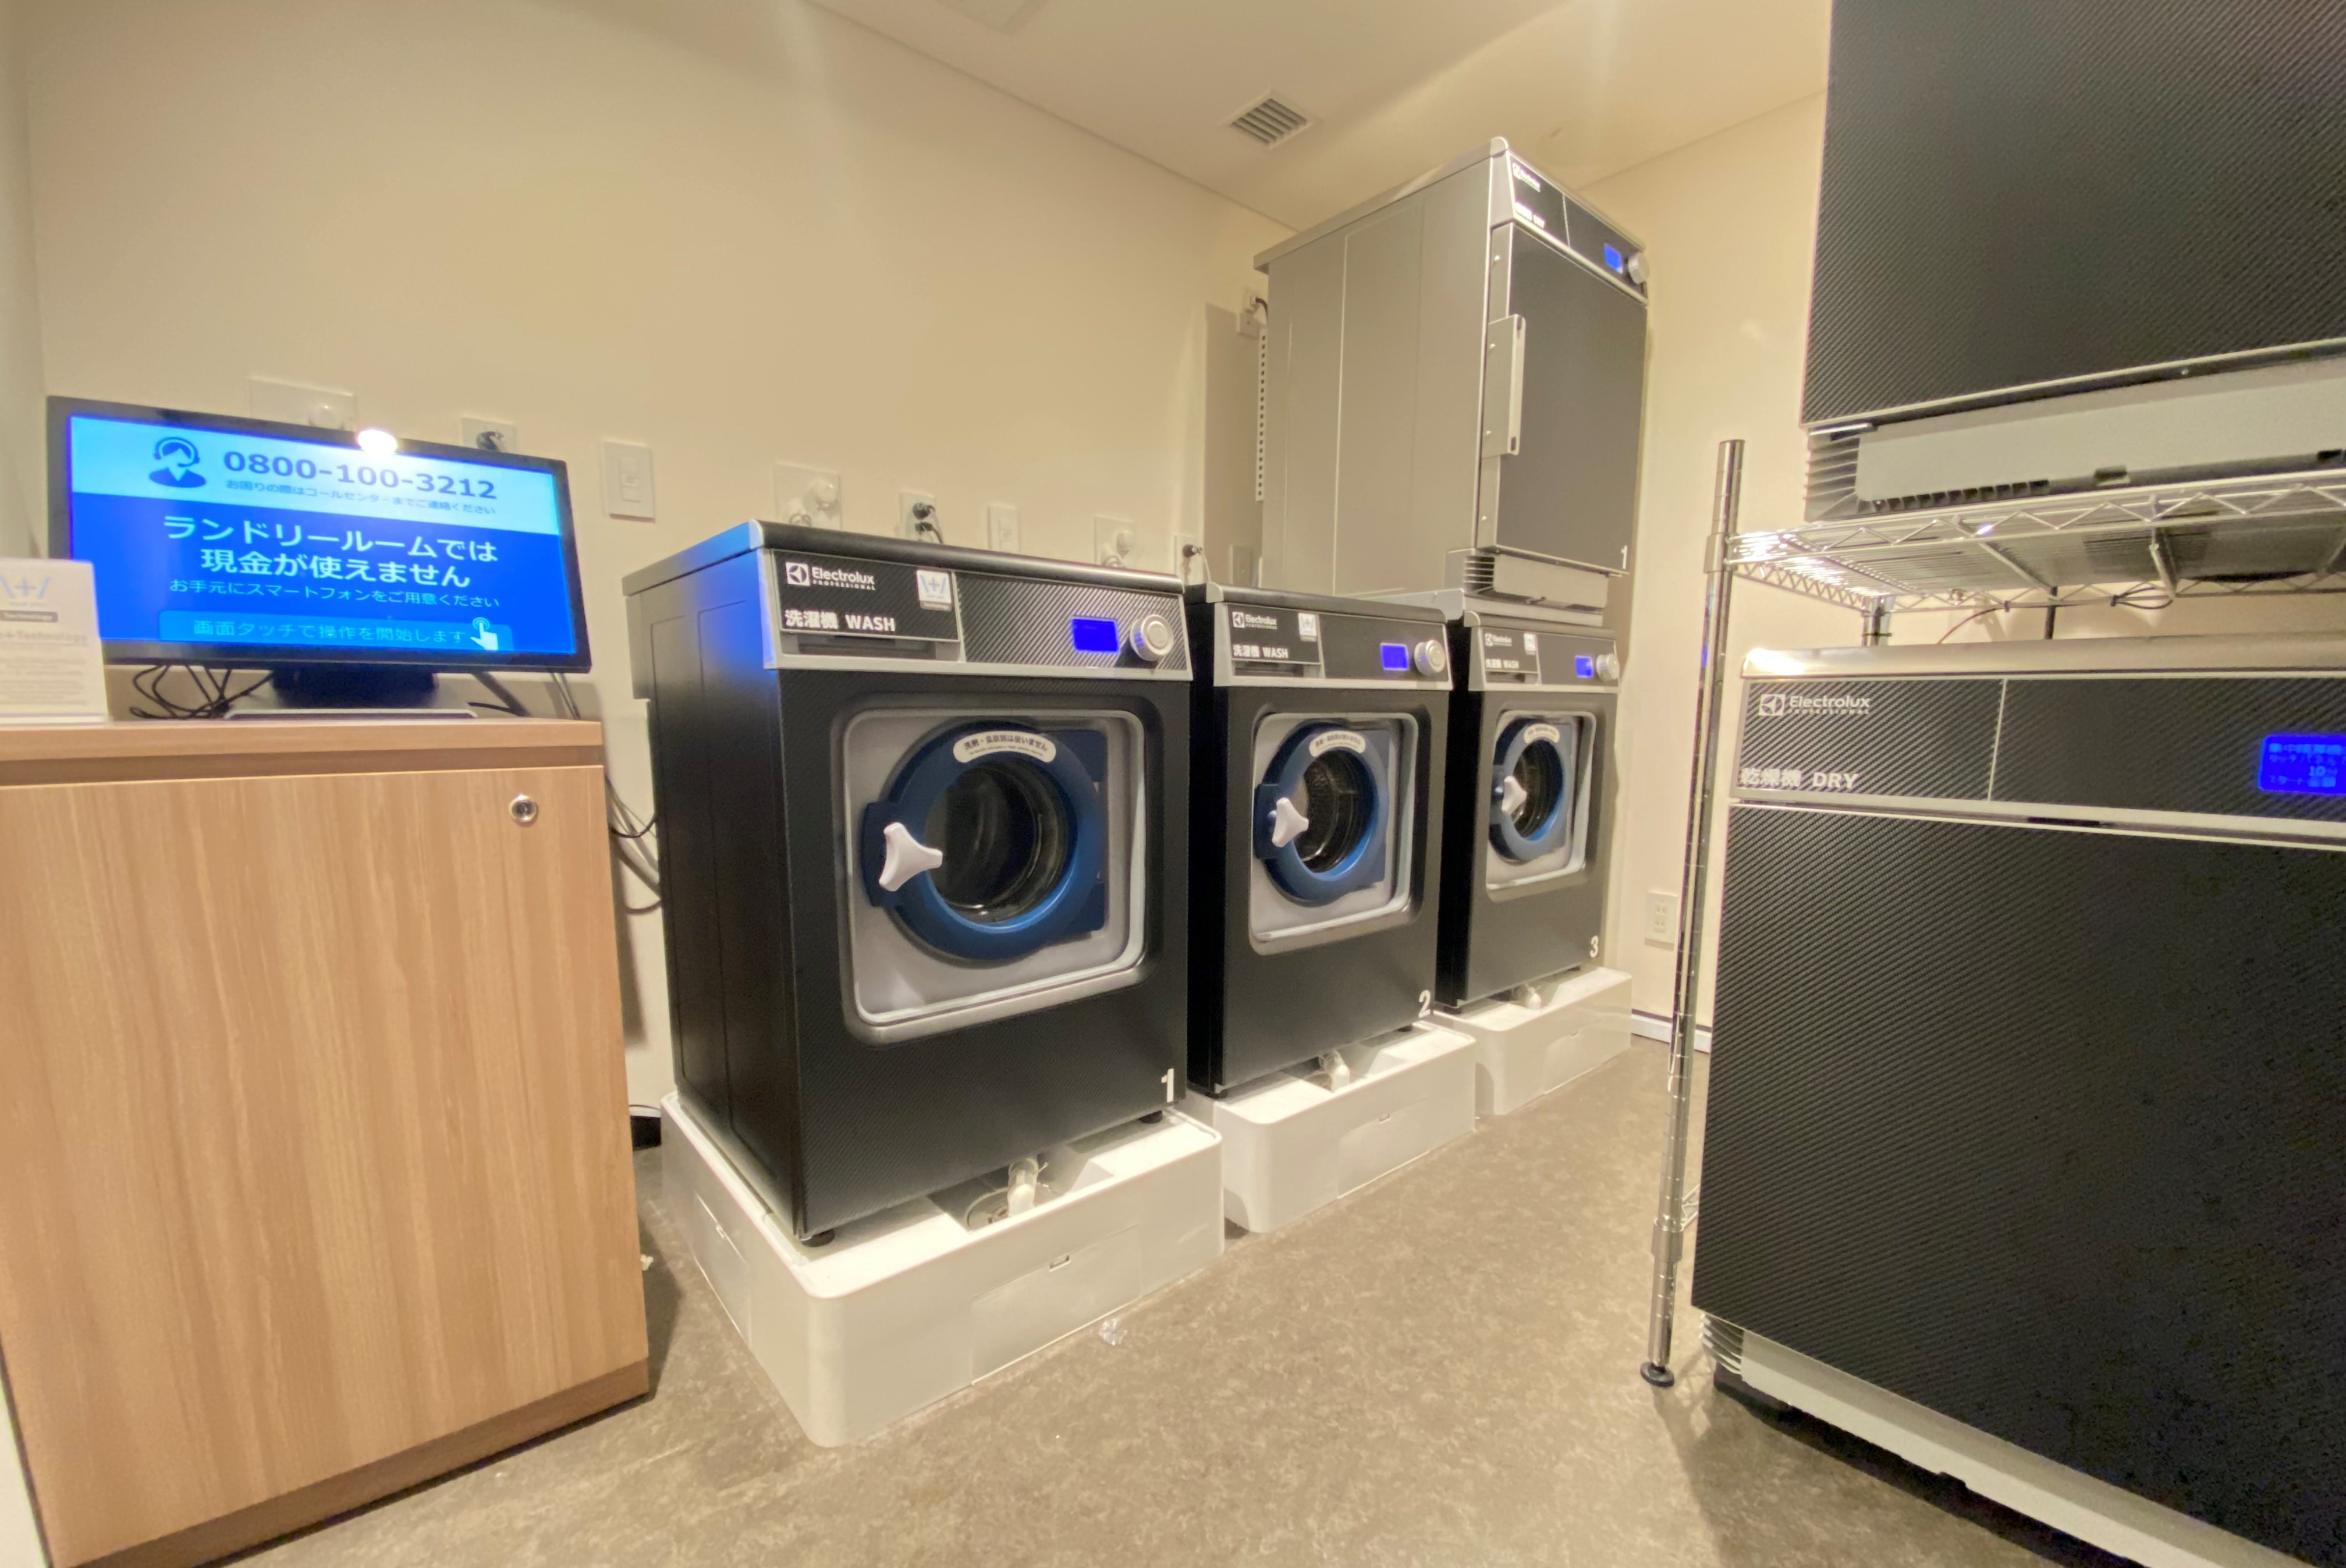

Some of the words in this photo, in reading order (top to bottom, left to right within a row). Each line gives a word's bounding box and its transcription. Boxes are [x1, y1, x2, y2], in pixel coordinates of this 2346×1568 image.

[224, 451, 497, 499] 0800-100-3212
[164, 516, 498, 562] ランドリールームでは
[201, 548, 471, 588] 現金が使えません
[1621, 545, 1628, 569] 1
[811, 567, 875, 585] Electrolux
[812, 580, 875, 591] PROFESSIONAL
[169, 579, 499, 608] お手元にスマートフォンをご用意ください
[845, 614, 895, 632] WASH
[1245, 614, 1277, 625] Electrolux
[194, 619, 465, 644] 画面タッチで操作を開始します
[1262, 647, 1289, 658] WASH
[1789, 695, 1871, 708] Electrolux
[1812, 772, 1859, 789] DRY
[1590, 935, 1599, 957] 3
[1418, 990, 1431, 1018] 2
[1161, 1068, 1174, 1103] 1
